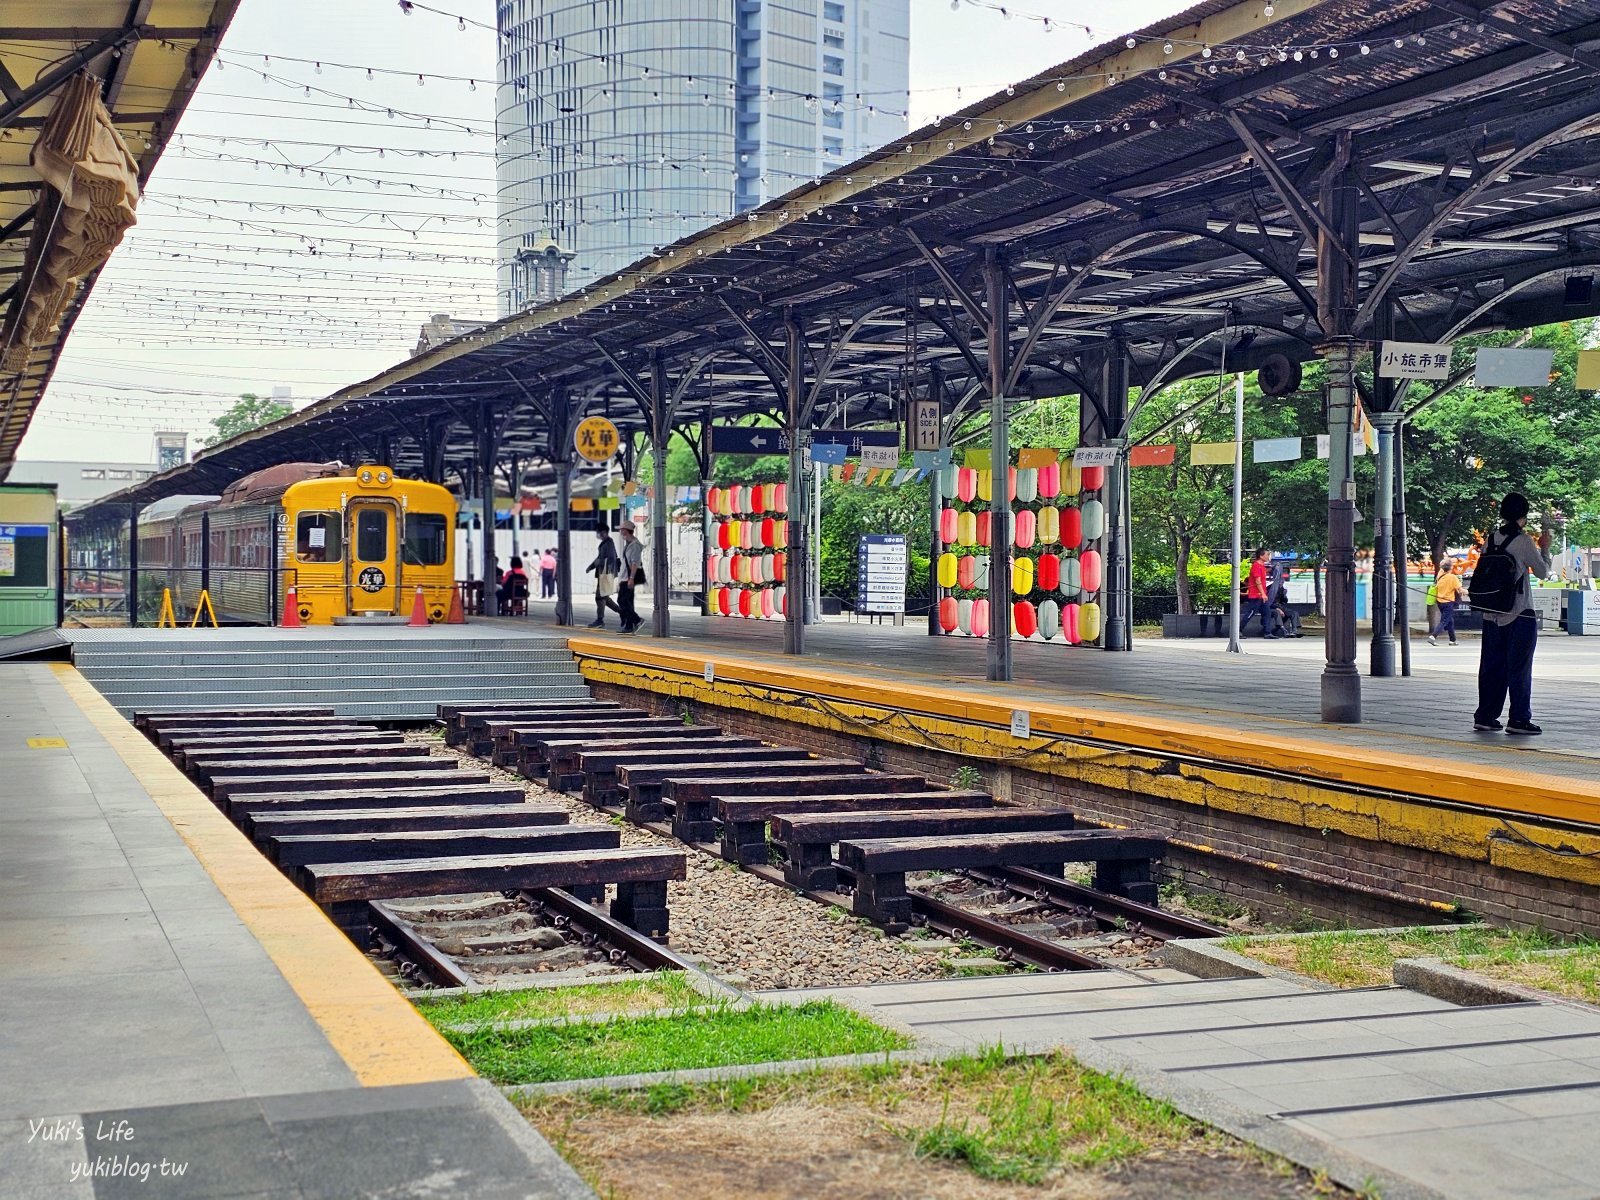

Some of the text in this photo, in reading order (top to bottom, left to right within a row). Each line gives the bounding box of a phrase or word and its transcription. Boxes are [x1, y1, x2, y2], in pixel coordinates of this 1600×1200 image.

[1384, 351, 1448, 368] 小旅市集
[581, 429, 614, 447] 光華
[921, 430, 935, 445] 11
[361, 573, 384, 585] 光華
